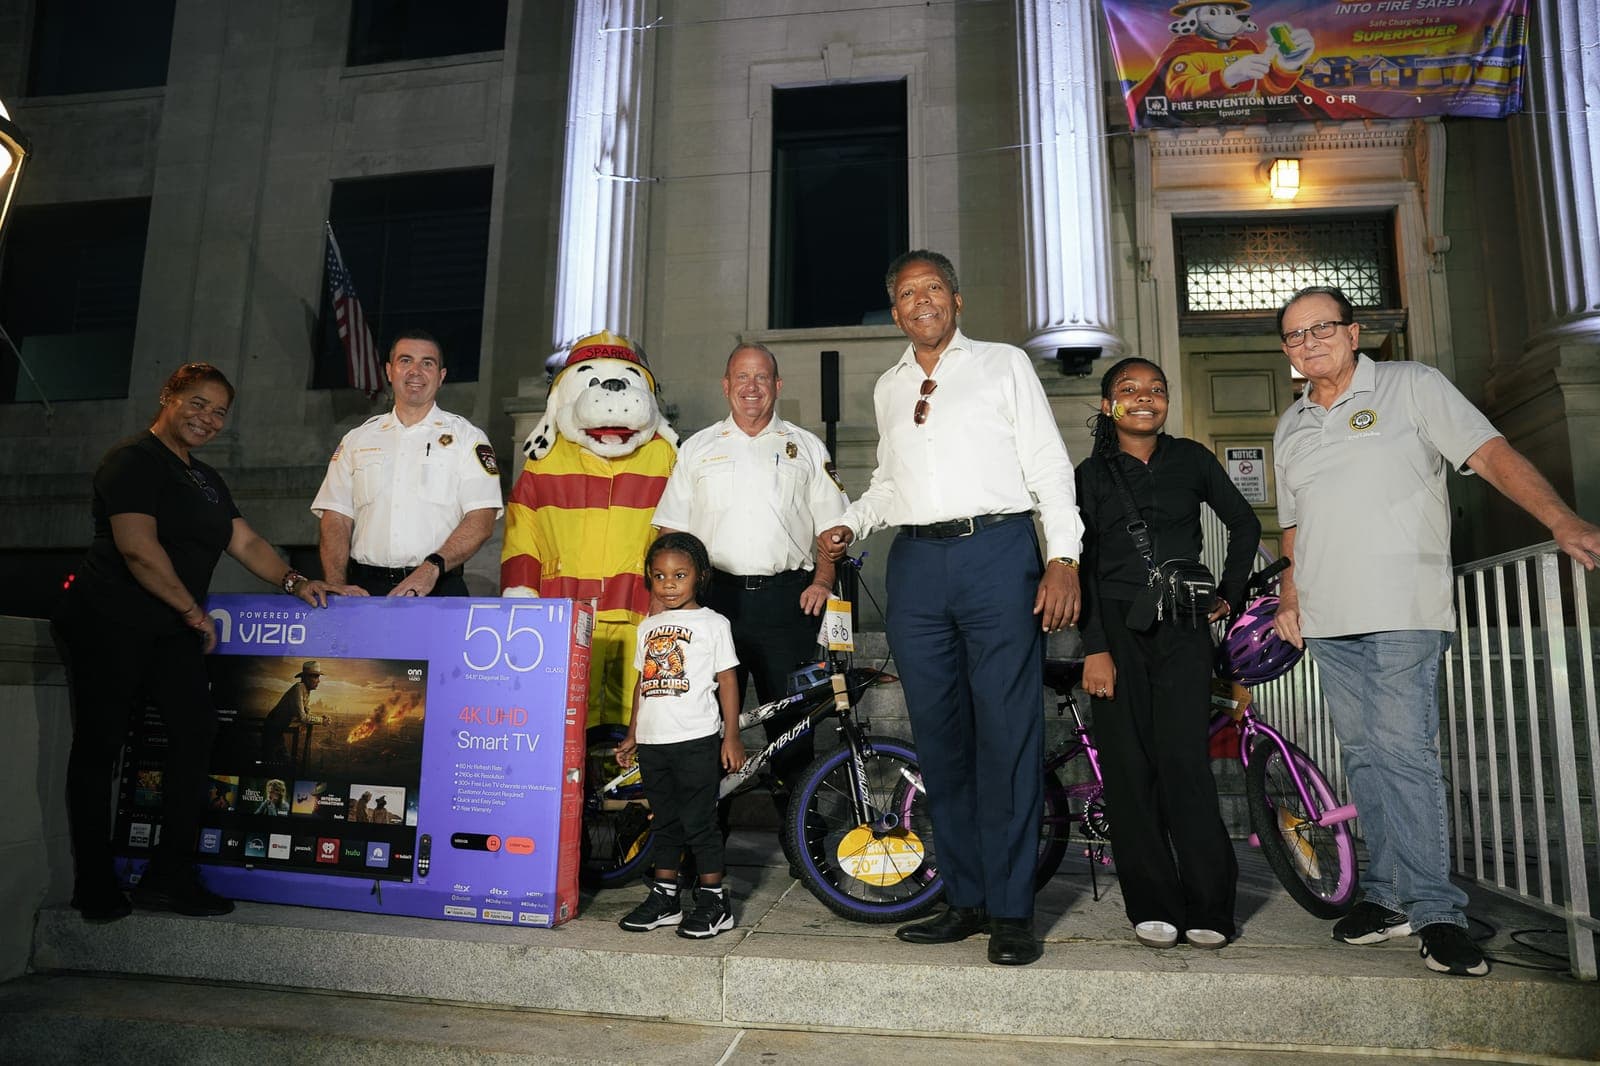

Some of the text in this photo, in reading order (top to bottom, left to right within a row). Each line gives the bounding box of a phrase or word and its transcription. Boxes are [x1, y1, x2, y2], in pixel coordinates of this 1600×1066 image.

[1336, 3, 1372, 14] INTO
[1376, 1, 1411, 12] FIRE
[1369, 19, 1387, 28] Safe
[1388, 18, 1426, 27] Charging
[1352, 24, 1458, 42] SUPERPOWER
[1171, 101, 1194, 111] FIRE
[1196, 97, 1266, 109] PREVENTION
[1218, 108, 1251, 118] fpw.org
[585, 347, 632, 359] SPARKY
[1232, 450, 1258, 459] NOTICE
[240, 611, 308, 620] POWERED BY
[239, 623, 306, 645] VIZIO
[463, 604, 564, 672] 55"
[644, 625, 692, 645] LINDEN
[661, 678, 689, 691] CUBS
[459, 705, 529, 727] 4K UHD
[457, 730, 509, 751] Smart
[512, 733, 541, 753] TV
[345, 848, 361, 856] hulu
